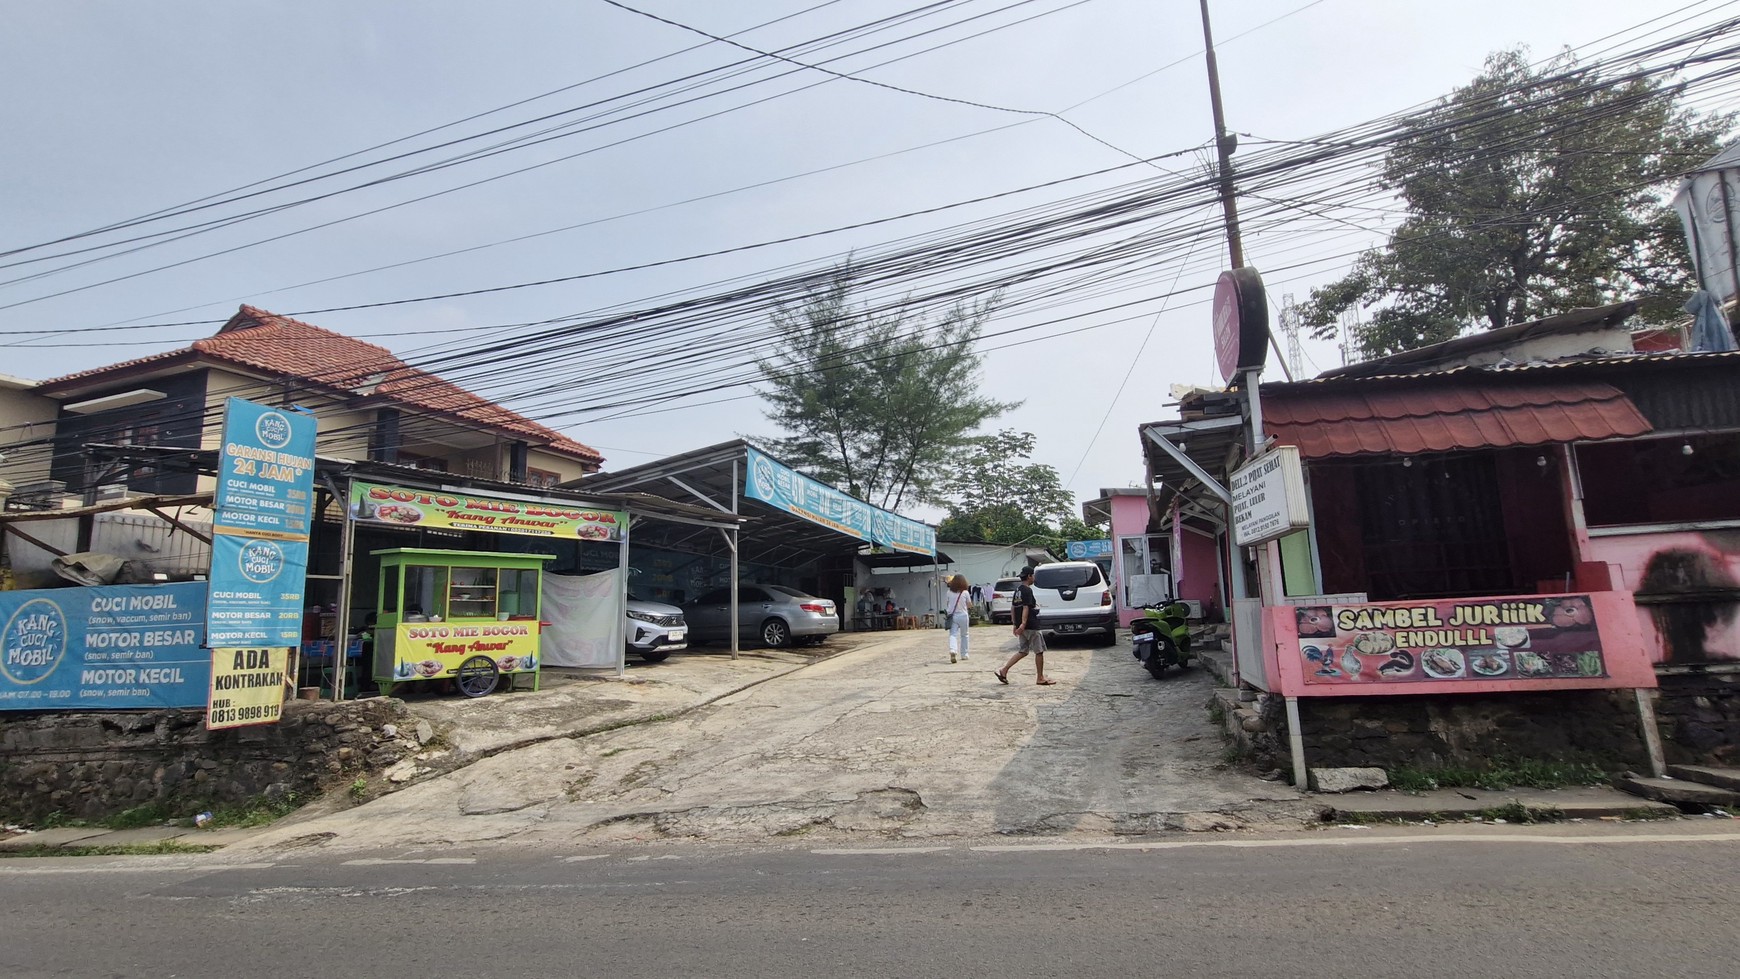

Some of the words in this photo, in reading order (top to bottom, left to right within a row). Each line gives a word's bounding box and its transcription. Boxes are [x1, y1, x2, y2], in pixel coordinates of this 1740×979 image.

[265, 420, 285, 431] KANG
[263, 431, 285, 441] MOBIL
[227, 443, 277, 463] GARANSI
[278, 453, 312, 470] HUJAN
[233, 458, 256, 476] 24
[1249, 467, 1263, 483] PIJAT
[1264, 456, 1281, 476] SEHAT
[249, 483, 276, 493] MOBIL
[1233, 481, 1266, 502] MELAYANI
[226, 496, 258, 506] MOTOR
[260, 500, 285, 510] BESAR
[369, 487, 460, 508] SOTO
[465, 498, 520, 515] MIE
[525, 503, 617, 524] BOGOR
[1250, 493, 1266, 507] LULUR
[222, 512, 256, 522] MOTOR
[258, 516, 280, 525] KECIL
[1236, 511, 1253, 525] BEKAM
[1242, 520, 1258, 531] MELAYANI
[1259, 512, 1280, 525] PANGGILAN
[249, 547, 277, 560] KANG
[252, 557, 269, 565] CUCI
[246, 563, 276, 574] MOBIL
[92, 598, 126, 612] CUCI
[130, 595, 178, 610] MOBIL
[89, 616, 116, 625] (snow,
[117, 615, 148, 623] vaccum,
[173, 612, 192, 621] ban)
[1338, 607, 1443, 631] SAMBEL
[1450, 602, 1547, 627] JURiiiK
[18, 614, 58, 637] KANG
[410, 628, 450, 639] SOTO
[453, 627, 479, 638] MIE
[483, 626, 529, 637] BOGOR
[21, 634, 48, 647] CUCI
[86, 633, 141, 648] MOTOR
[144, 630, 195, 646] BESAR
[1395, 627, 1493, 648] ENDULLL
[7, 644, 55, 666] MOBIL
[85, 652, 109, 661] (snow,
[111, 651, 132, 659] semir
[135, 651, 154, 659] ban)
[233, 650, 270, 671] ADA
[82, 670, 136, 685] MOTOR
[139, 669, 185, 684] KECIL
[216, 672, 283, 691] KONTRAKAN
[80, 689, 106, 698] (snow,
[108, 689, 130, 697] semir
[133, 688, 151, 697] ban)
[213, 699, 231, 709] HUB
[212, 709, 236, 724] 0813
[238, 706, 262, 720] 9898
